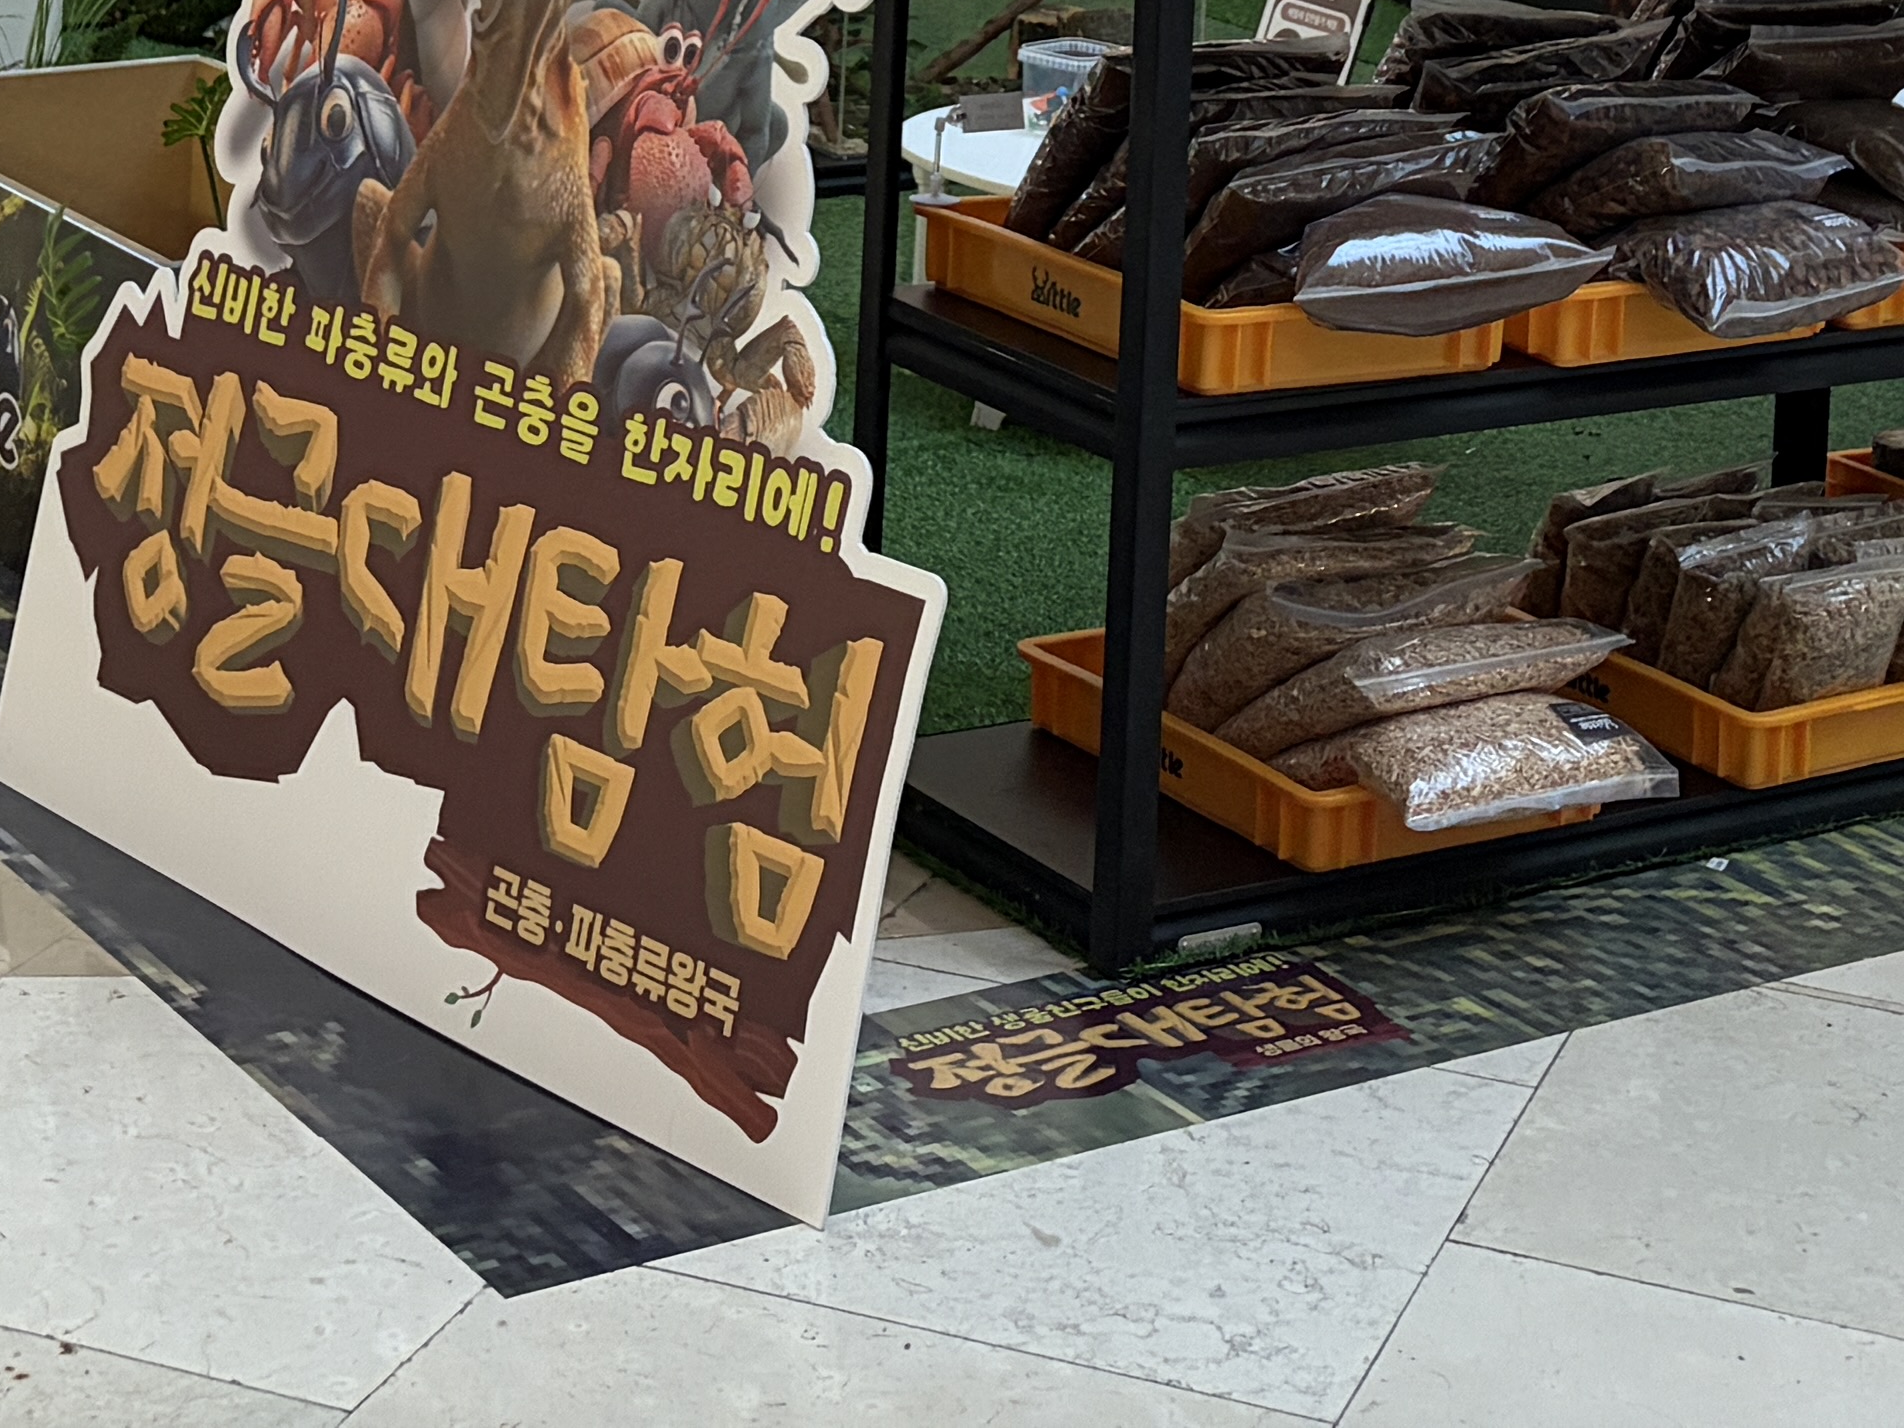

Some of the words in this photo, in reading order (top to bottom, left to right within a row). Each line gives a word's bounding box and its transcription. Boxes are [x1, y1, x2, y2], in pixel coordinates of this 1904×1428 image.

[190, 256, 297, 350] 신비한
[304, 304, 462, 406] 파충류와
[473, 359, 602, 466] 곤충을
[620, 410, 847, 552] 한자리에!
[94, 352, 885, 962] 정글대탐험
[483, 864, 743, 1038] 곤충·파충류왕국
[898, 1018, 991, 1053] 신비한
[907, 974, 1363, 1098] 정글대탐험
